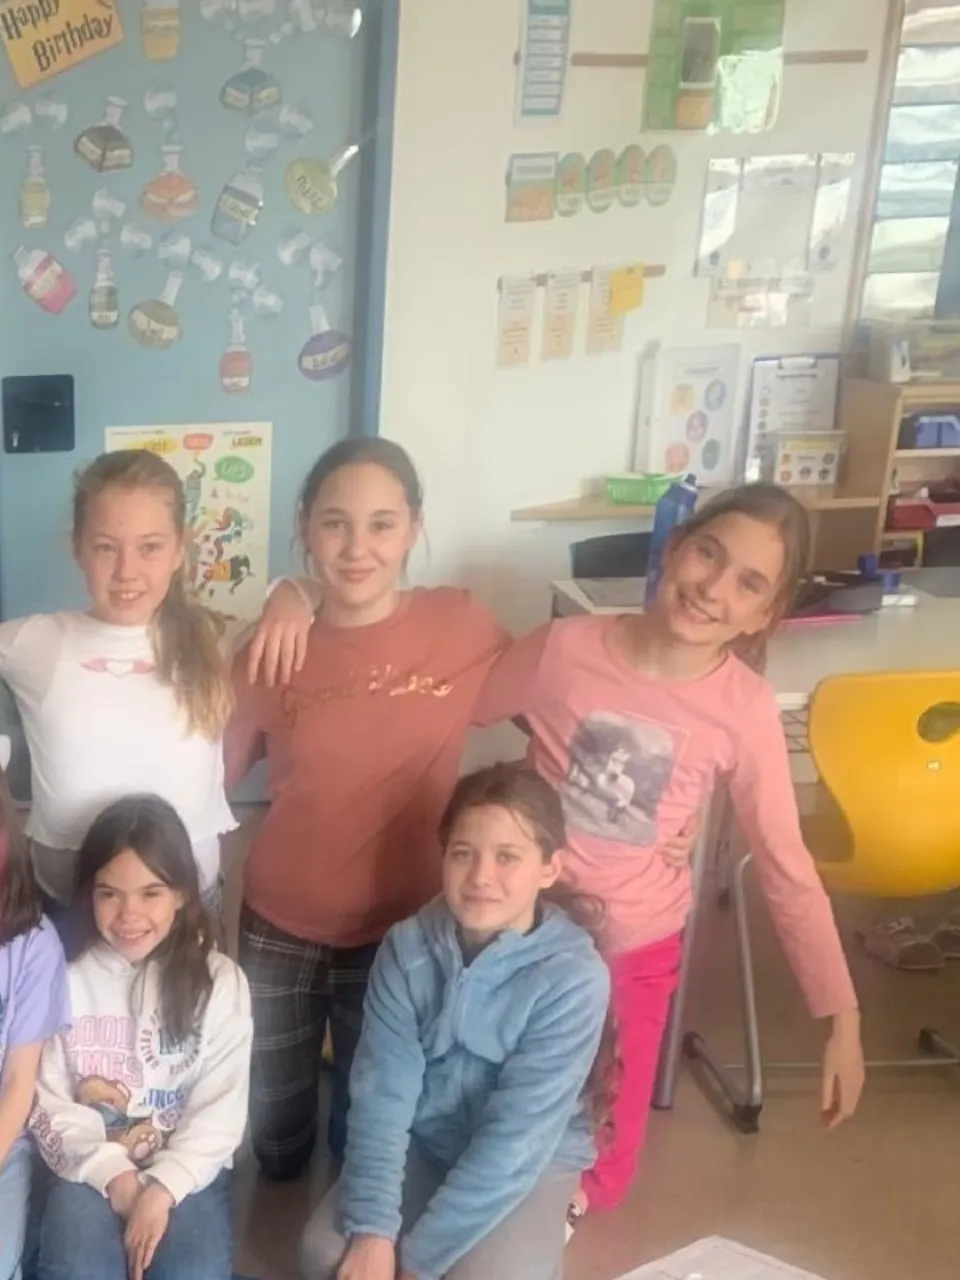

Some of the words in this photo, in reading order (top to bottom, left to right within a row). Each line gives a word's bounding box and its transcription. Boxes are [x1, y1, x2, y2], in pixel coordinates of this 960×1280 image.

[0, 0, 60, 40] Happy
[32, 13, 113, 72] Birthday
[67, 1050, 144, 1088] IMES
